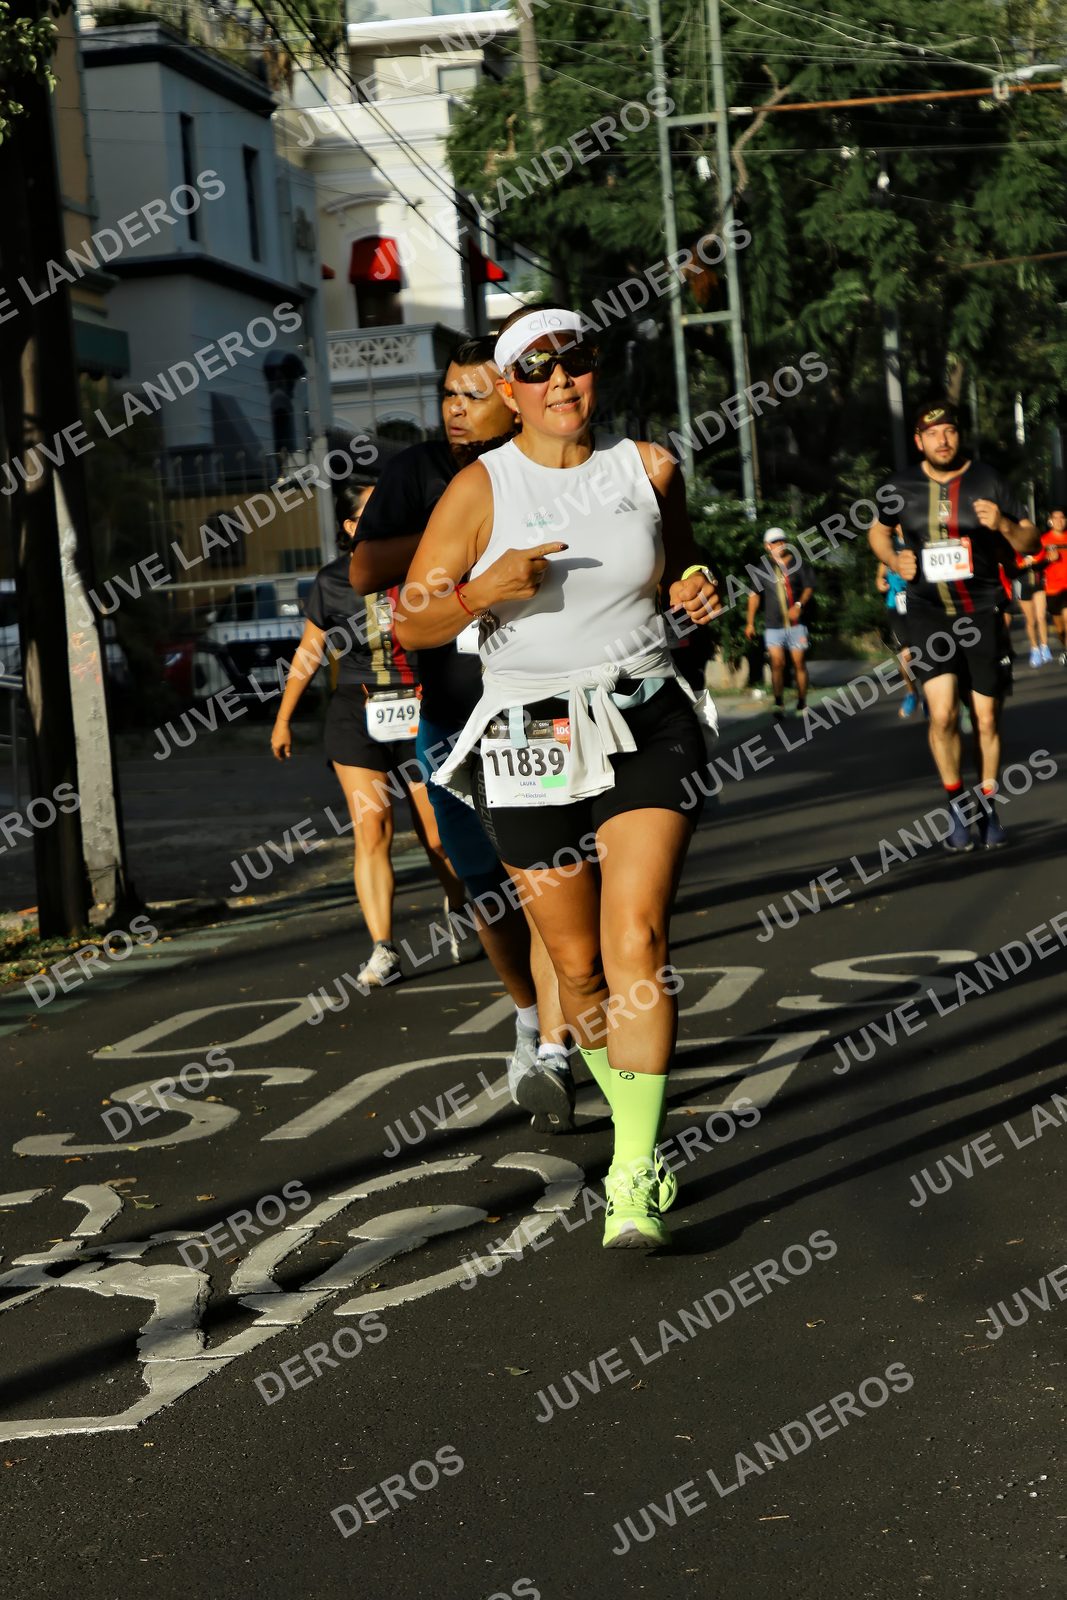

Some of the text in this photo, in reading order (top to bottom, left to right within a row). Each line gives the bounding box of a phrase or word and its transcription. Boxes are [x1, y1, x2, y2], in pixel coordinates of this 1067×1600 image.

[930, 551, 961, 567] 8019
[376, 704, 416, 724] 9749
[486, 747, 565, 777] 11839
